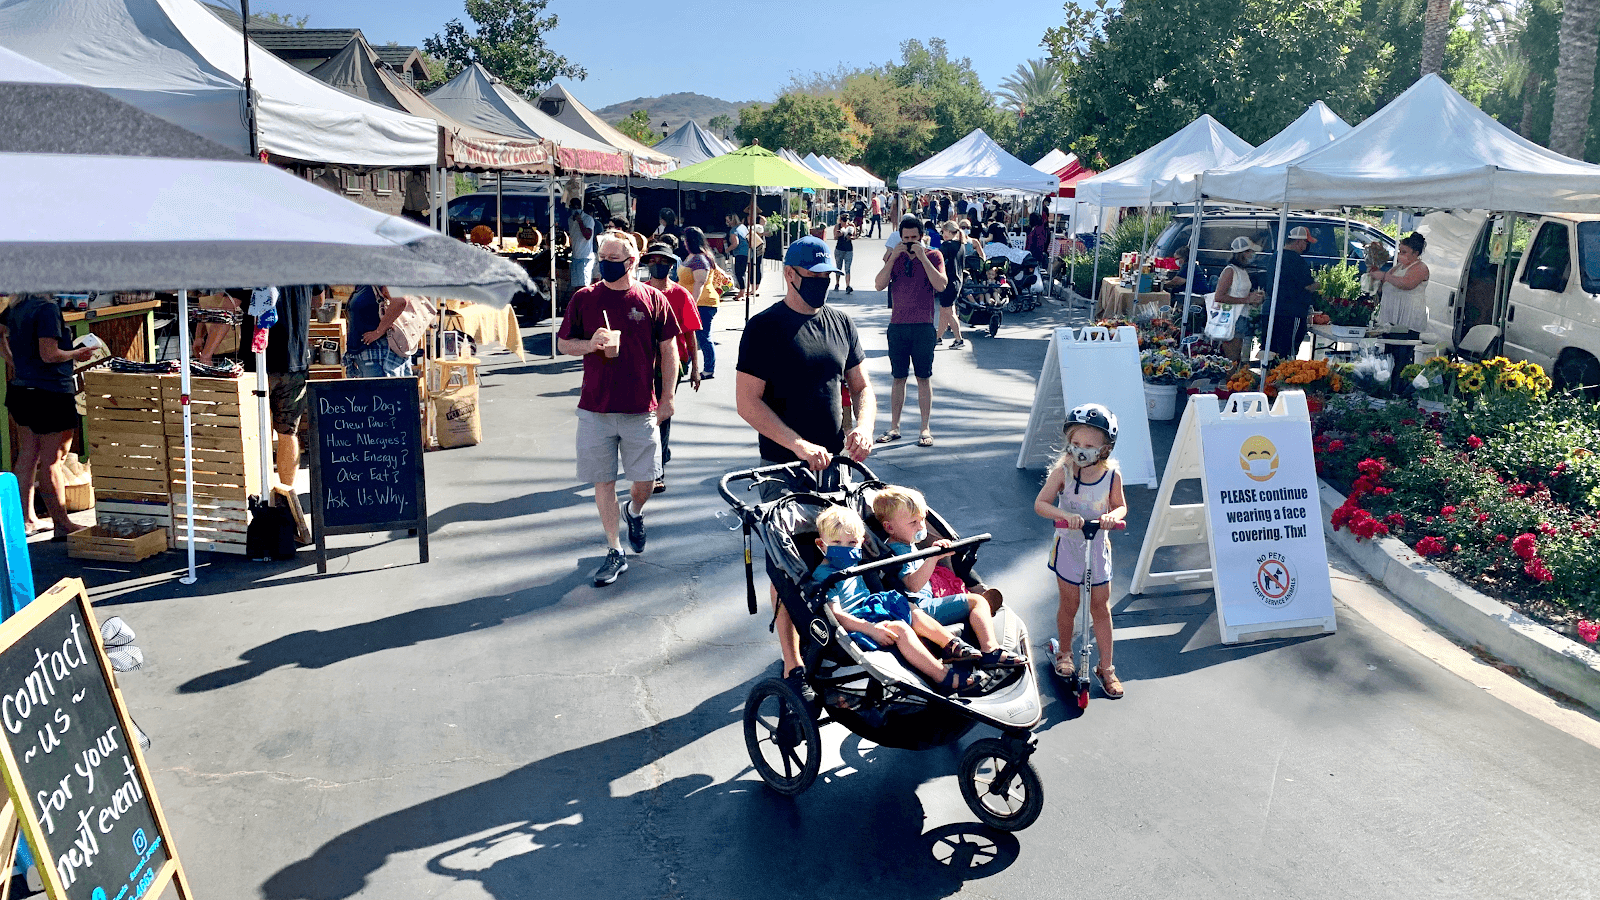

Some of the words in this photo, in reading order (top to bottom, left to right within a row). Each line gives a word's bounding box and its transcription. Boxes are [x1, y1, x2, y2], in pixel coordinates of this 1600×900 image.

[320, 397, 346, 415] Does
[345, 396, 369, 413] Your
[372, 395, 402, 415] Dog:
[334, 419, 363, 430] Chew
[326, 433, 351, 448] Have
[356, 431, 407, 449] Allergies?
[331, 451, 359, 463] Lack
[337, 468, 363, 483] Over
[327, 488, 349, 509] Ask
[357, 488, 374, 506] Us
[1220, 489, 1257, 504] PLEASE
[1259, 488, 1308, 502] continue
[1227, 508, 1272, 524] wearing
[1273, 509, 1281, 520] a
[1282, 506, 1306, 520] face
[1231, 527, 1283, 543] covering.
[1284, 524, 1307, 538] Thx!
[1256, 554, 1267, 565] NO
[1268, 551, 1286, 563] PETS
[1264, 597, 1286, 606] SERVICE
[1285, 577, 1296, 601] ANIMALS
[38, 774, 73, 834] for
[75, 725, 118, 794] your
[57, 805, 99, 890] next
[99, 756, 143, 834] event
